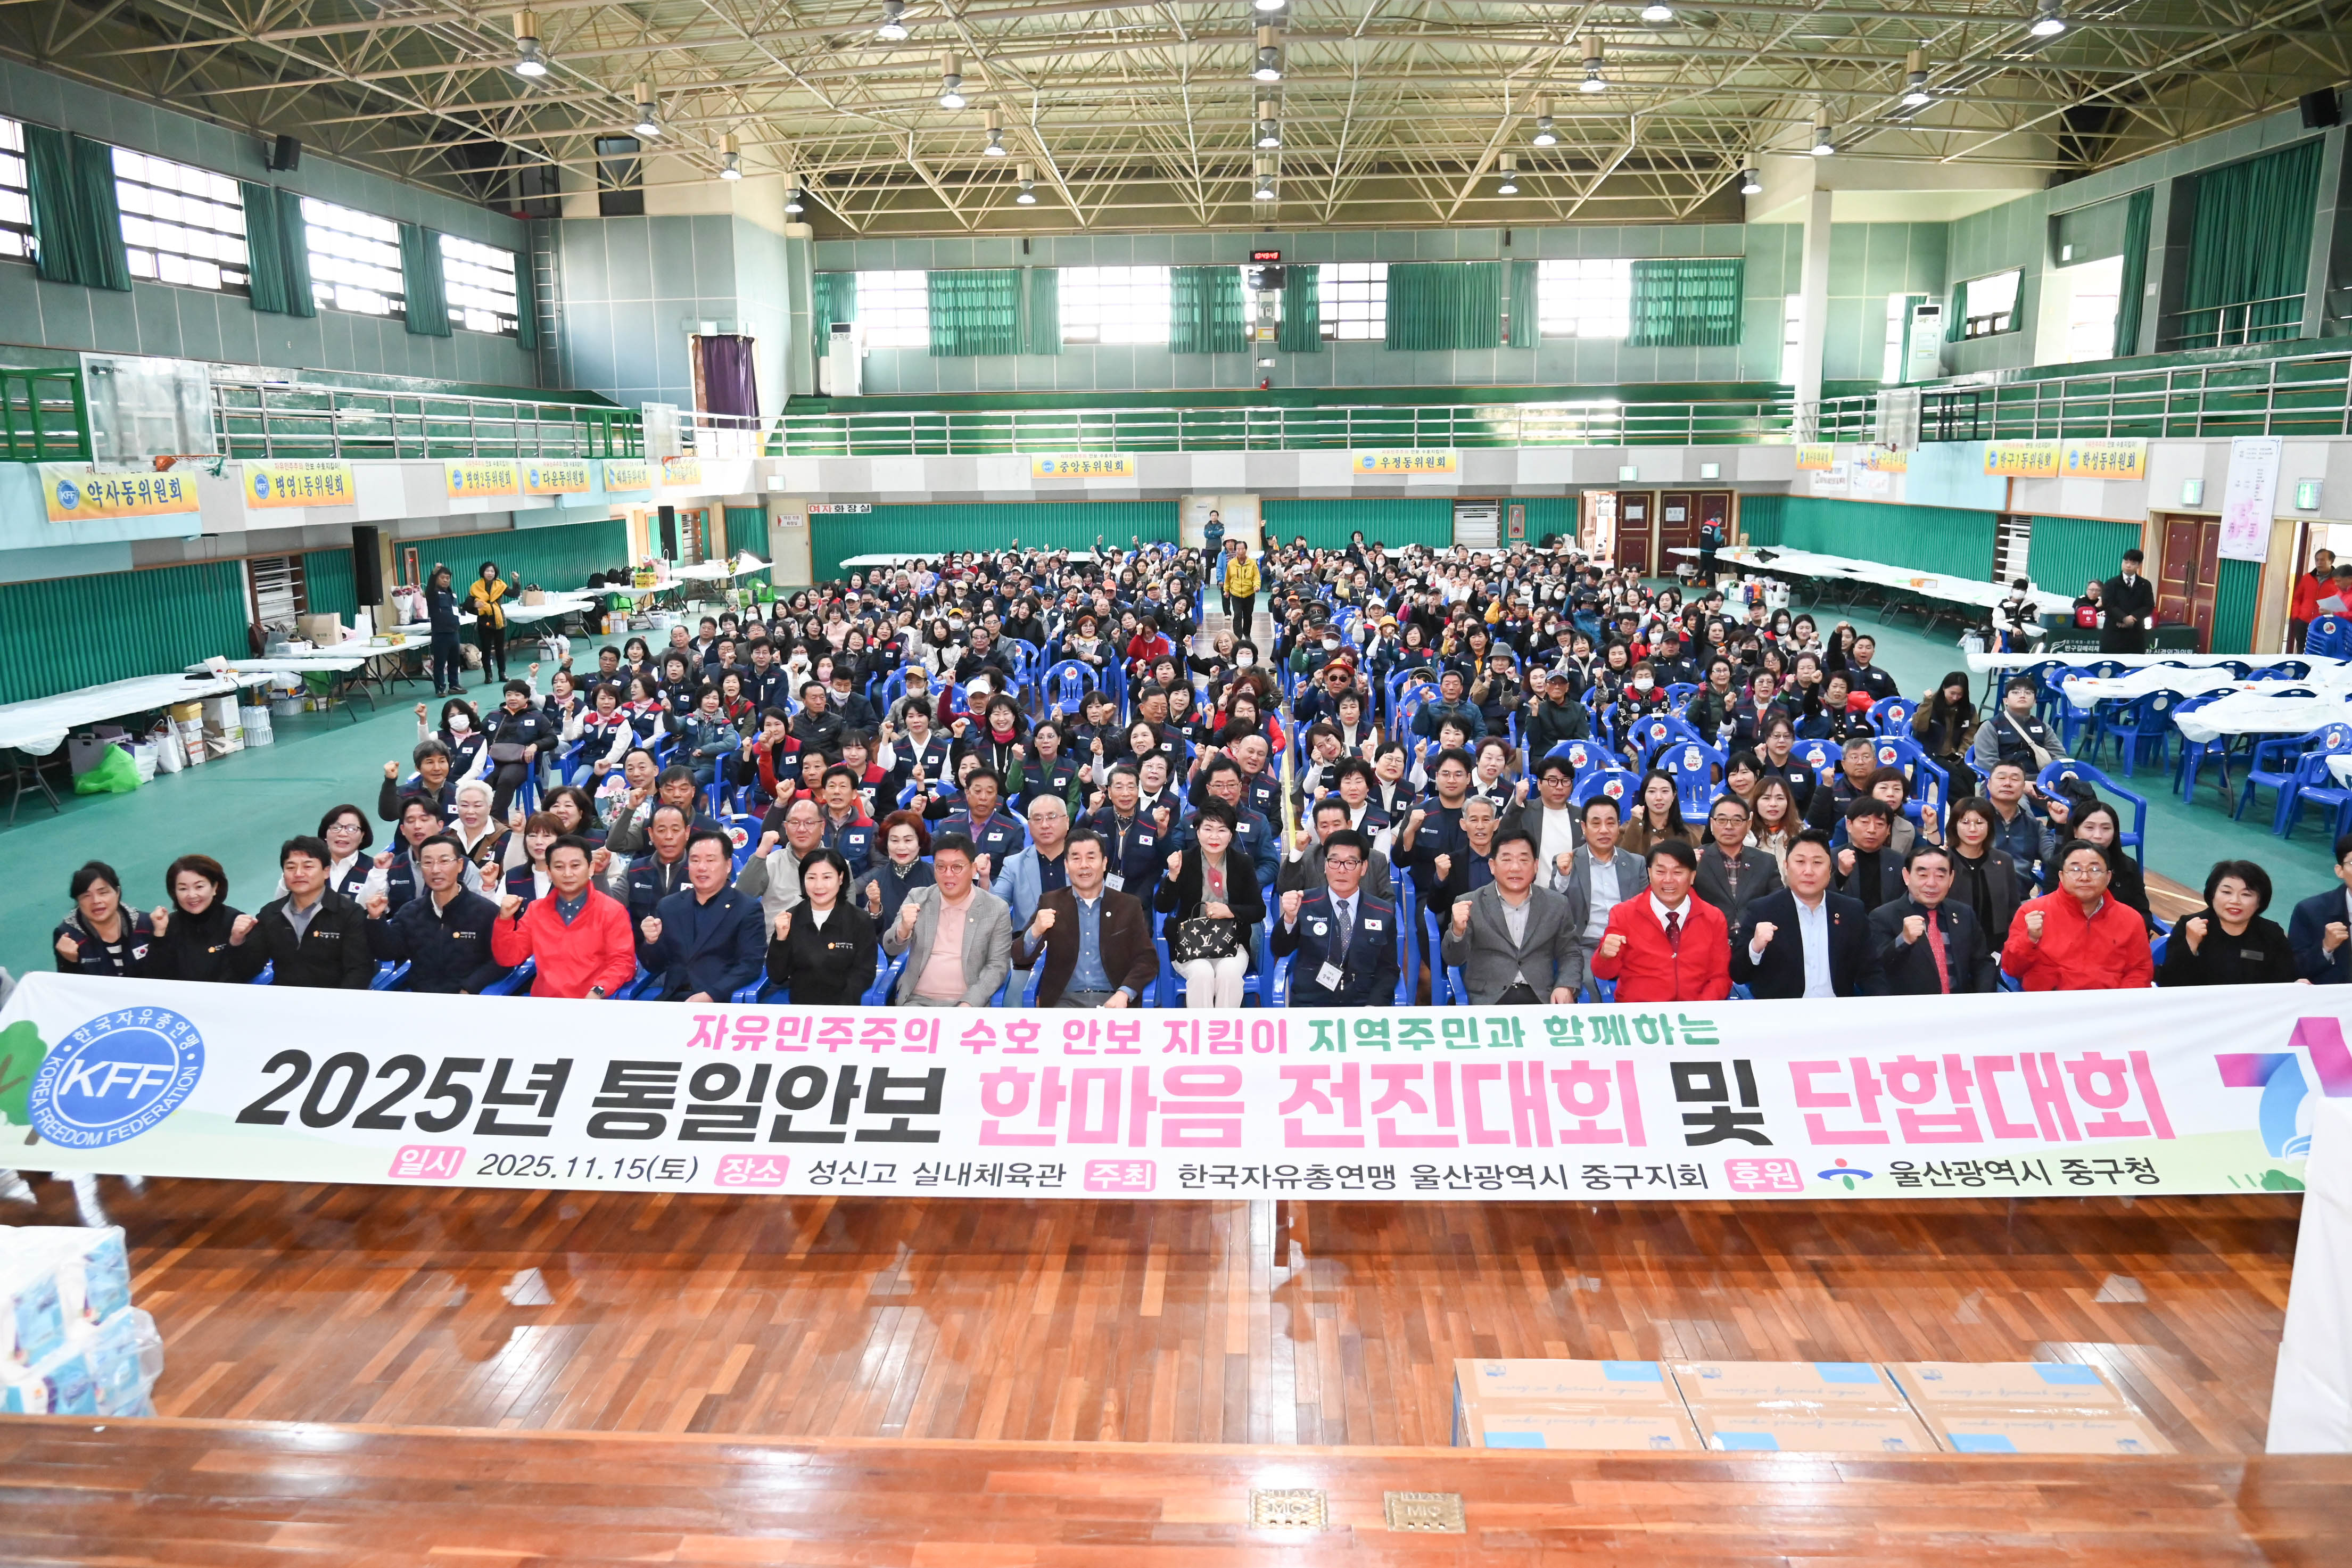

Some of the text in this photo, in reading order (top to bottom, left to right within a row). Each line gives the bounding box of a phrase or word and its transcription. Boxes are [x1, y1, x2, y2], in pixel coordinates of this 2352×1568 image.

[1060, 460, 1124, 473] 중앙동위원회
[1381, 456, 1446, 468] 우정동위원회
[2001, 452, 2051, 469] 반구1동위원회
[2083, 452, 2135, 472] 학성동위원회
[276, 475, 344, 498] 병영1동위원회
[466, 471, 511, 489] 병영2동위원회
[543, 471, 584, 488] 다운동위원회
[61, 491, 75, 499] KFF
[87, 477, 182, 508] 약사동위원회
[72, 1009, 200, 1050] 한국자유총연맹
[687, 1013, 1720, 1055] 자유민주주의 수호 안보 지킴이 지역주민과 함께하는
[59, 1059, 175, 1099] KFF
[31, 1056, 199, 1145] KOREA FREEDOM FEDERATION
[235, 1049, 2176, 1148] 2025년 통일안보 한마음 전진대회 및 단합대회
[398, 1150, 2160, 1190] 일시 2025.11.15(토) 장소 성신고 실내체육관 주최 한국자유총연맹 울산광역시 중구지회 후원 울산광역시 중구청
[1272, 1503, 1305, 1514] MIC
